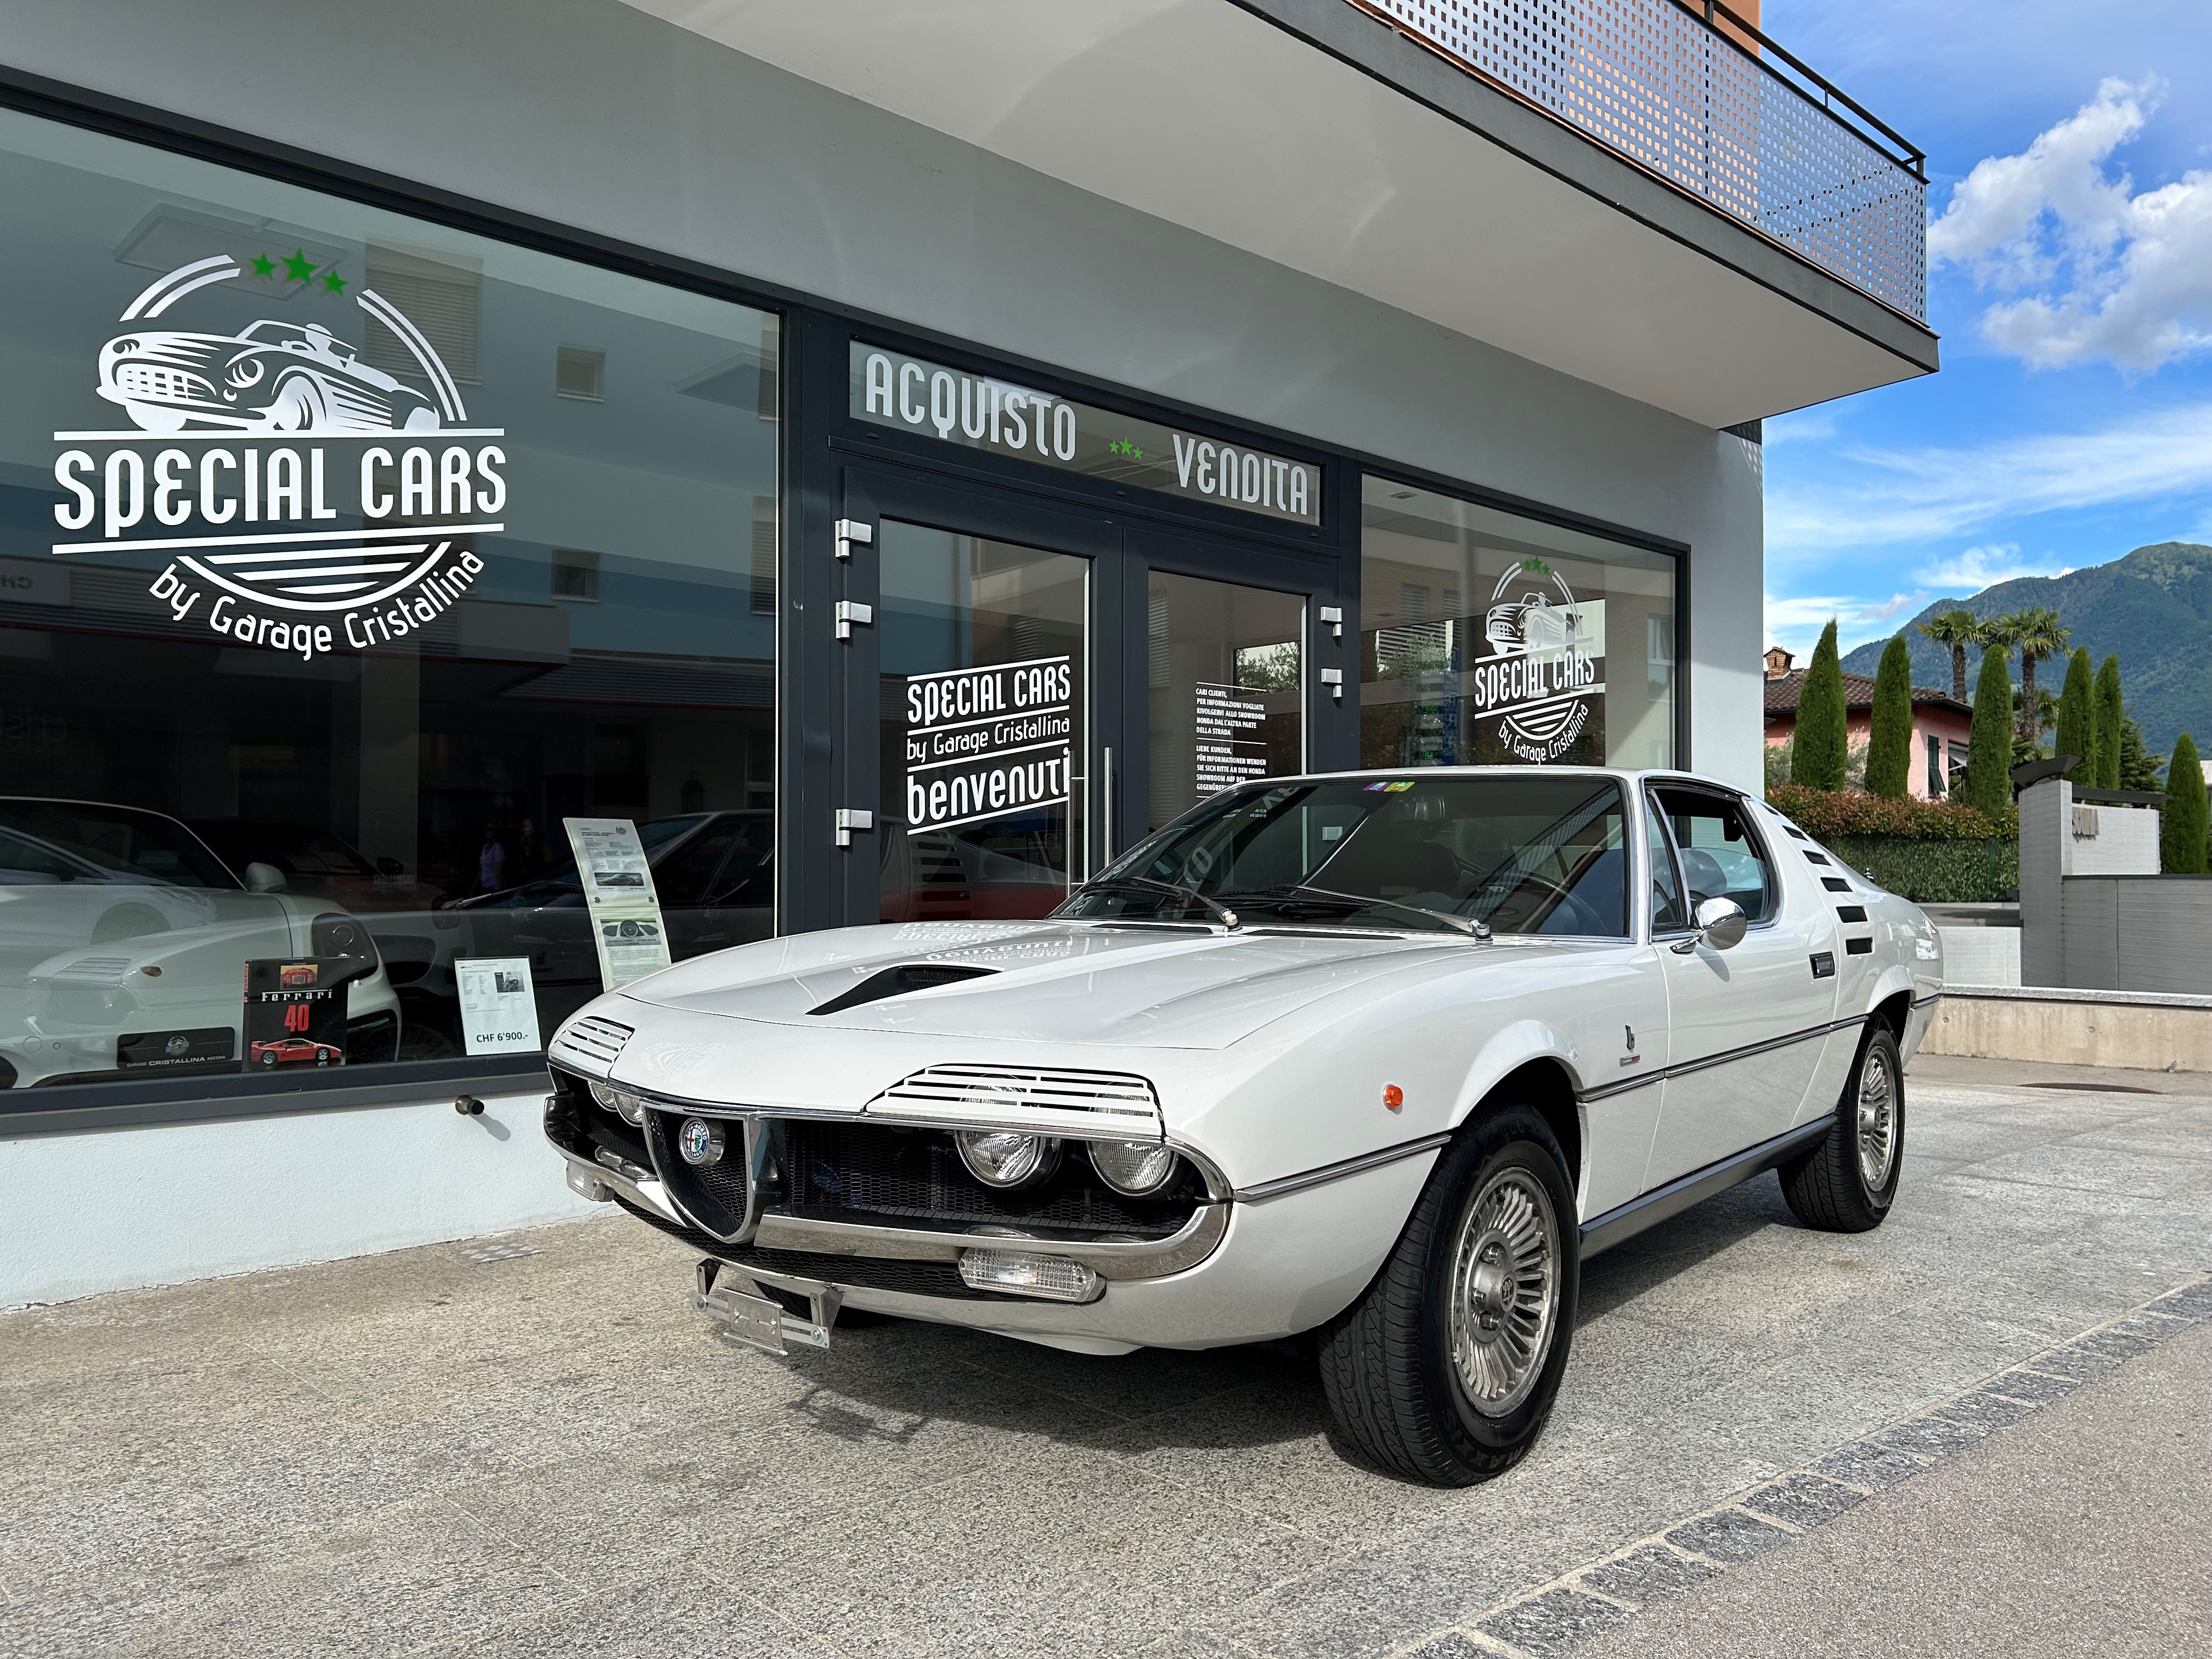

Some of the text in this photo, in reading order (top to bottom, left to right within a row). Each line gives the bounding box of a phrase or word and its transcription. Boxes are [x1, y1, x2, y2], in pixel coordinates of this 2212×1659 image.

[866, 353, 1076, 461] ACQUISTO
[1172, 434, 1308, 516] VENDITA
[54, 445, 506, 538] SPECIAL CARS
[149, 550, 484, 661] by Garage Cristallina
[1208, 689, 1227, 698] CLIENTI,
[1475, 656, 1547, 709] SPECIAL
[1553, 650, 1594, 691] CARS
[907, 664, 1070, 725] SPECIAL CARS
[1207, 698, 1242, 709] INFORMAZIONI
[1243, 702, 1264, 711] VOGLIATE
[1197, 708, 1224, 716] RIVOLGERVI
[1238, 712, 1266, 720] SHOWROOM
[907, 715, 1070, 763] by Garage Cristallina
[1498, 704, 1588, 766] by Garage Cristallina
[1206, 755, 1245, 764] INFORMATIONEN
[1211, 746, 1232, 754] KUNDEN,
[907, 747, 1069, 825] benvenuti
[1196, 774, 1225, 782] SHOWROOM
[262, 989, 332, 1002] Ferrari
[284, 1004, 309, 1032] 40
[477, 1032, 528, 1042] CHF 6'900.-
[149, 1057, 205, 1066] CRISTALLINA
